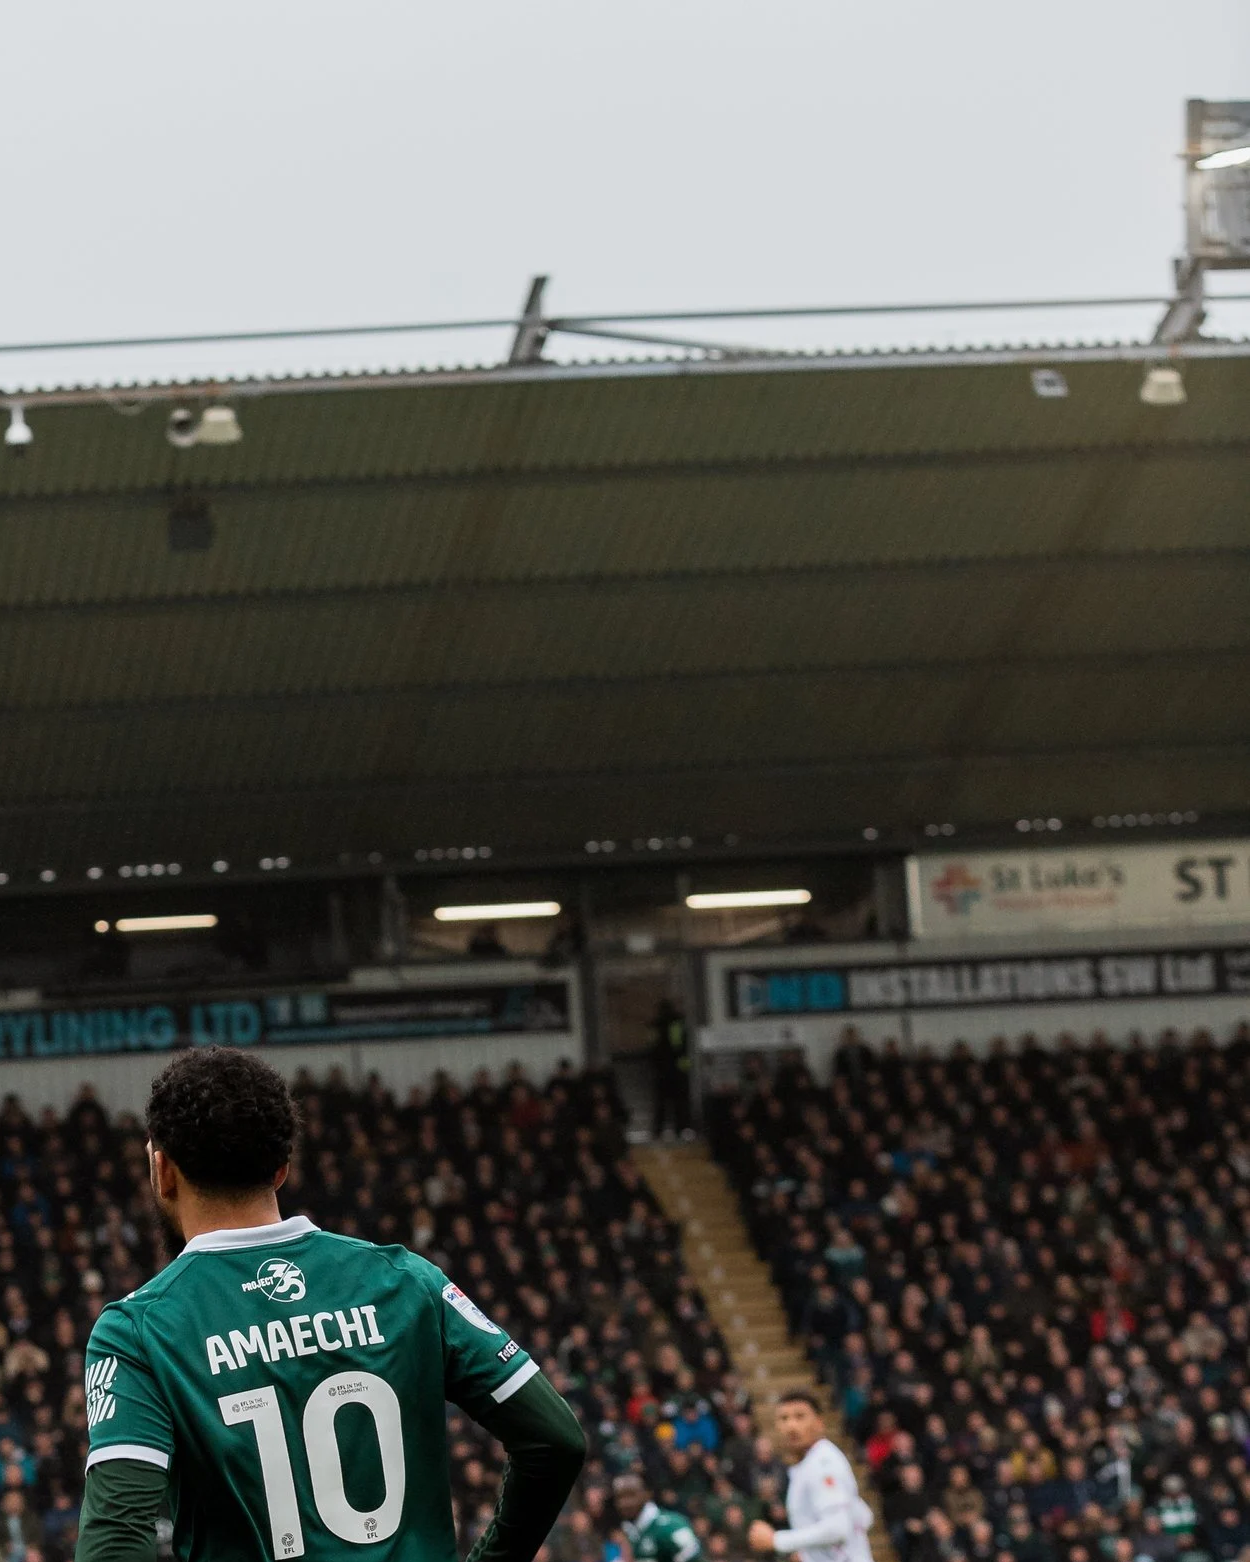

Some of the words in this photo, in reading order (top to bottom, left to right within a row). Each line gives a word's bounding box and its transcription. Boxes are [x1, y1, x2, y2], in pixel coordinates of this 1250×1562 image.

[187, 1001, 261, 1046] LTD
[241, 1276, 274, 1293] PROJECT
[267, 1263, 306, 1301] 35
[205, 1305, 385, 1375] AMAECHI
[338, 1386, 369, 1396] COMMUNITY
[217, 1370, 406, 1561] 10
[284, 1547, 295, 1555] EFL
